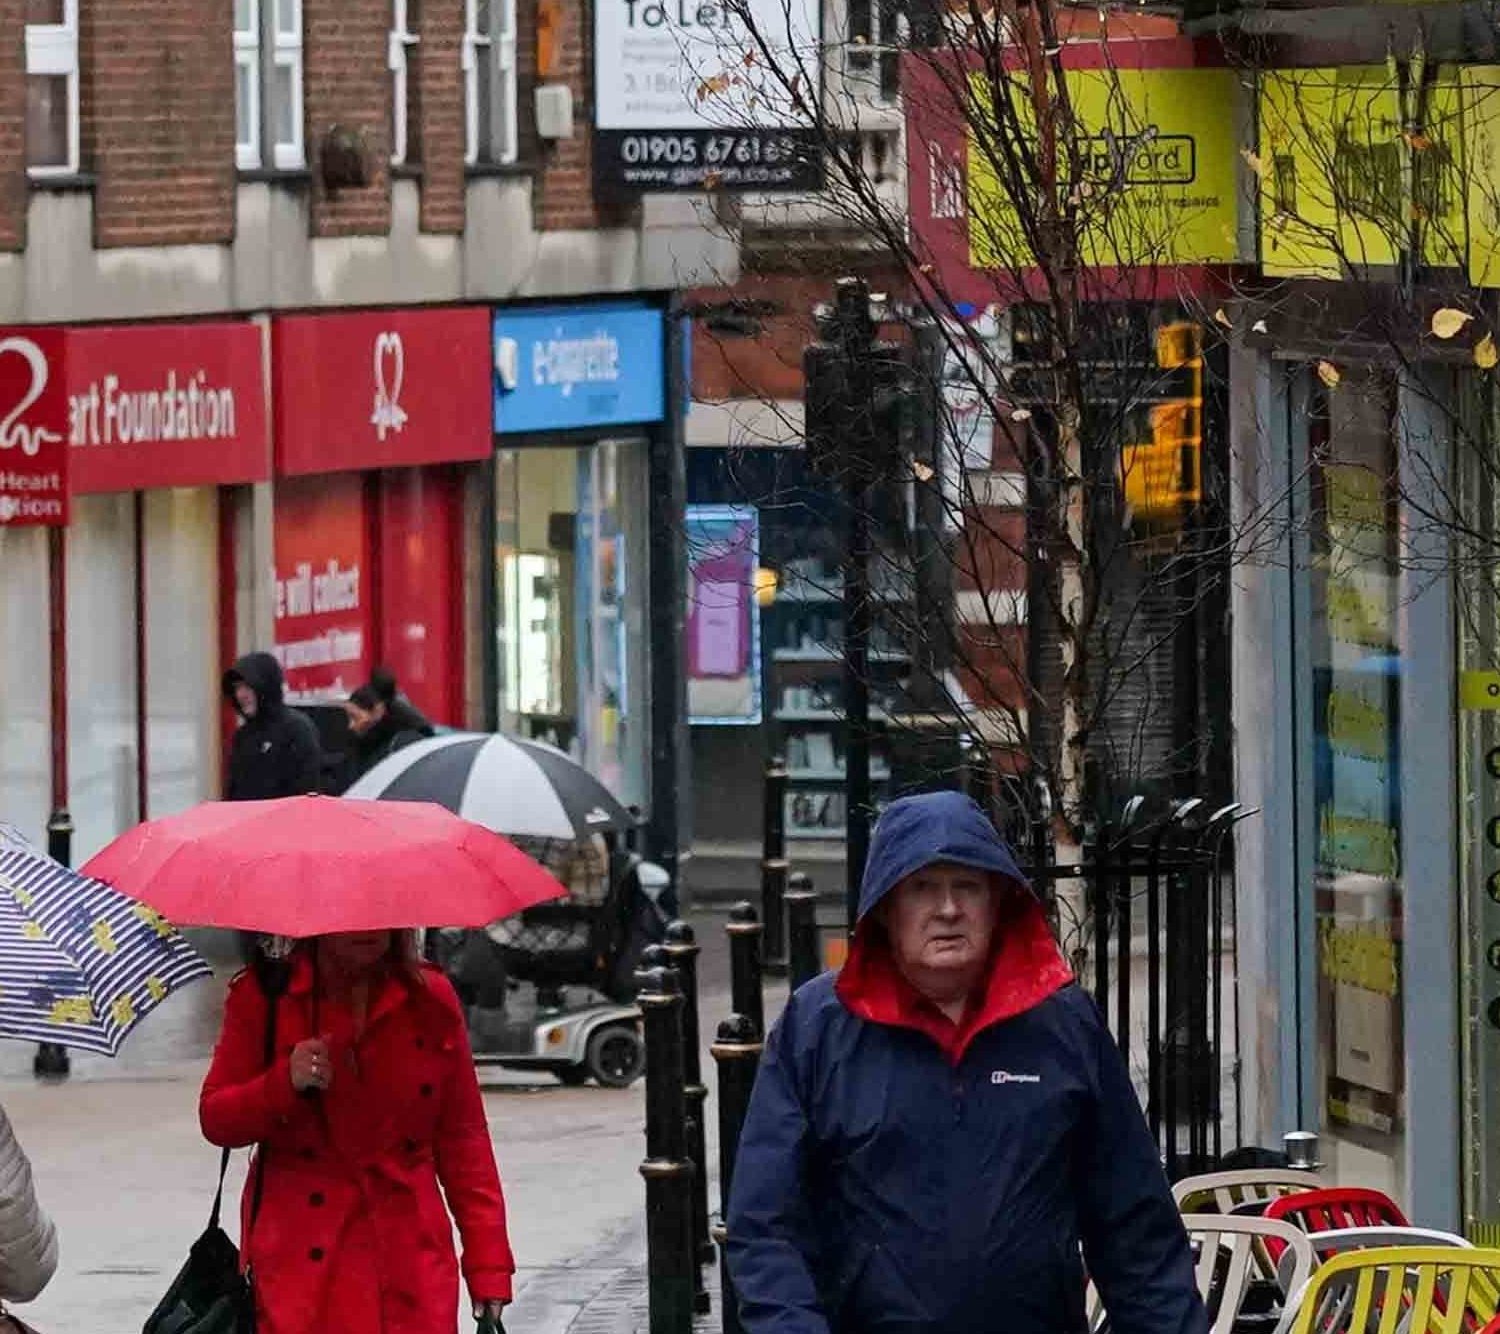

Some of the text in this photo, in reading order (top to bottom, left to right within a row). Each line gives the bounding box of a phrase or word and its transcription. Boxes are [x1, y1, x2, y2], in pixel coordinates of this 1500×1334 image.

[622, 137, 697, 163] 01905
[69, 367, 236, 446] art Foundation
